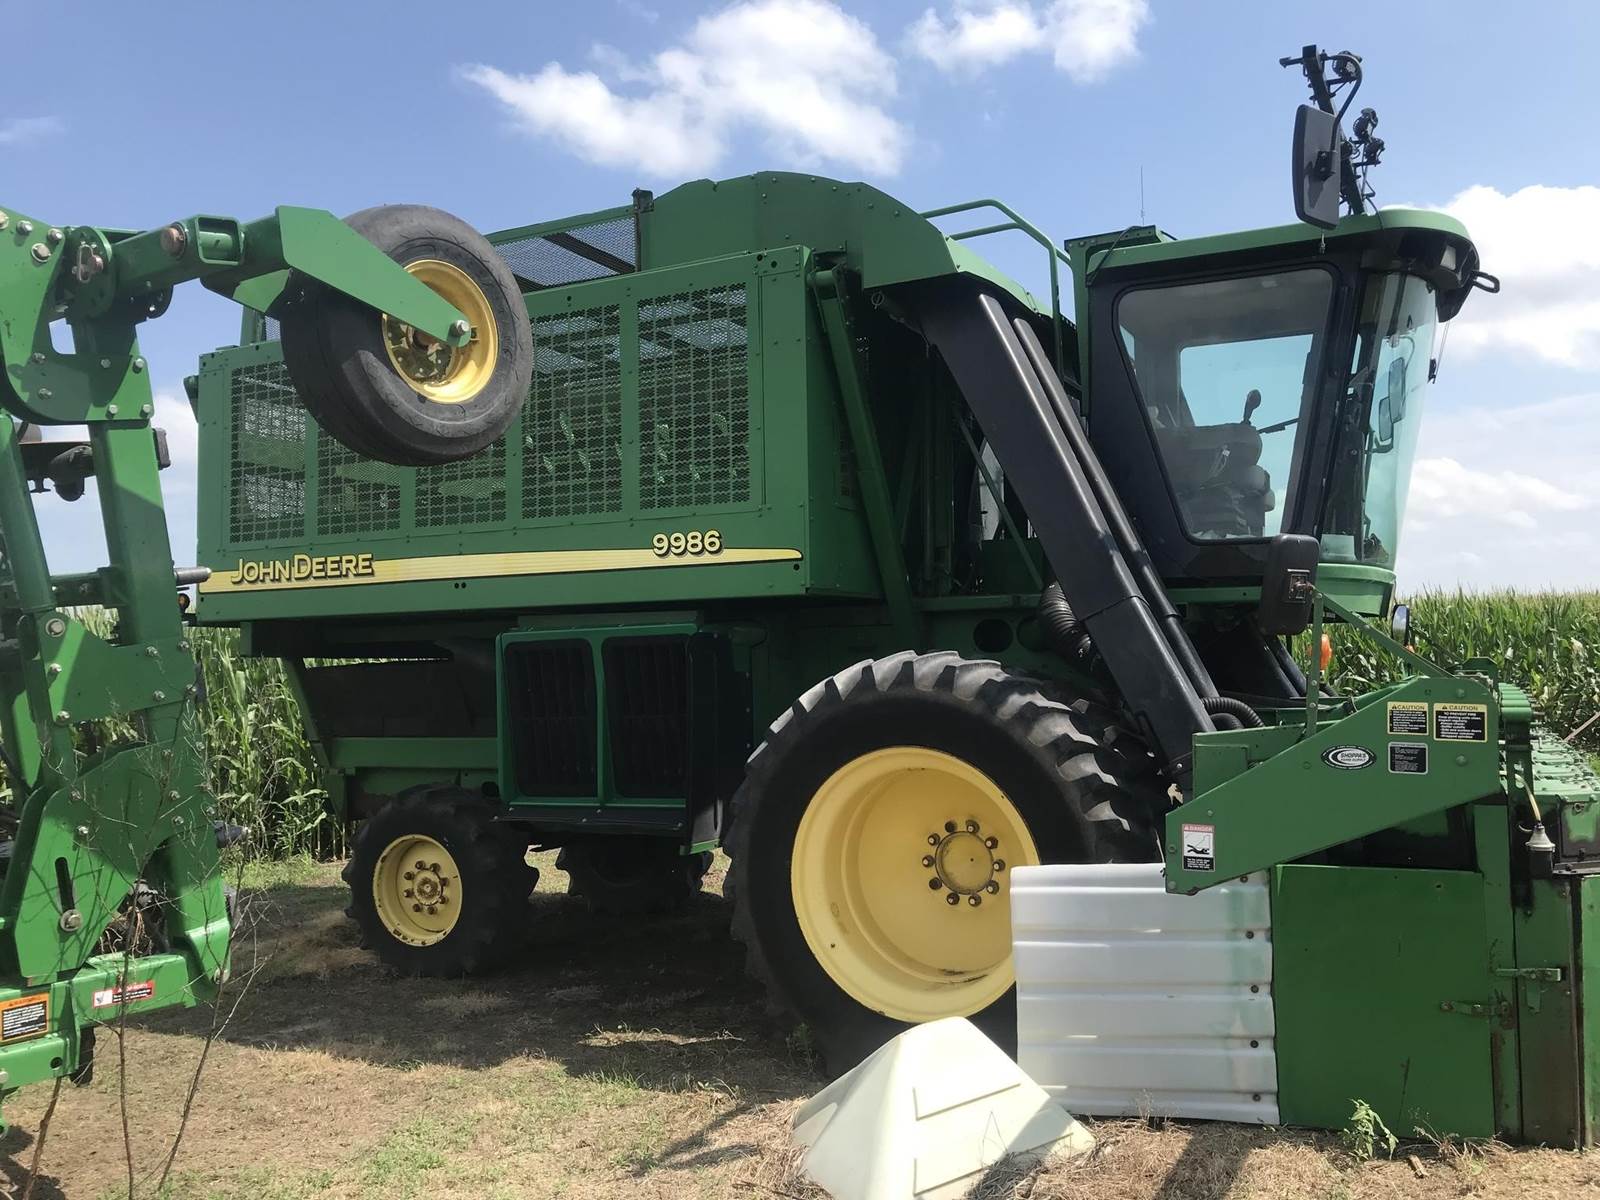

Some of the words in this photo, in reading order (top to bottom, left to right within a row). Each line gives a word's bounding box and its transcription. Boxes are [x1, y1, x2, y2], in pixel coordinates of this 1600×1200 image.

[652, 530, 722, 556] 9986
[231, 558, 290, 583] JOHN
[294, 553, 374, 579] DEERE
